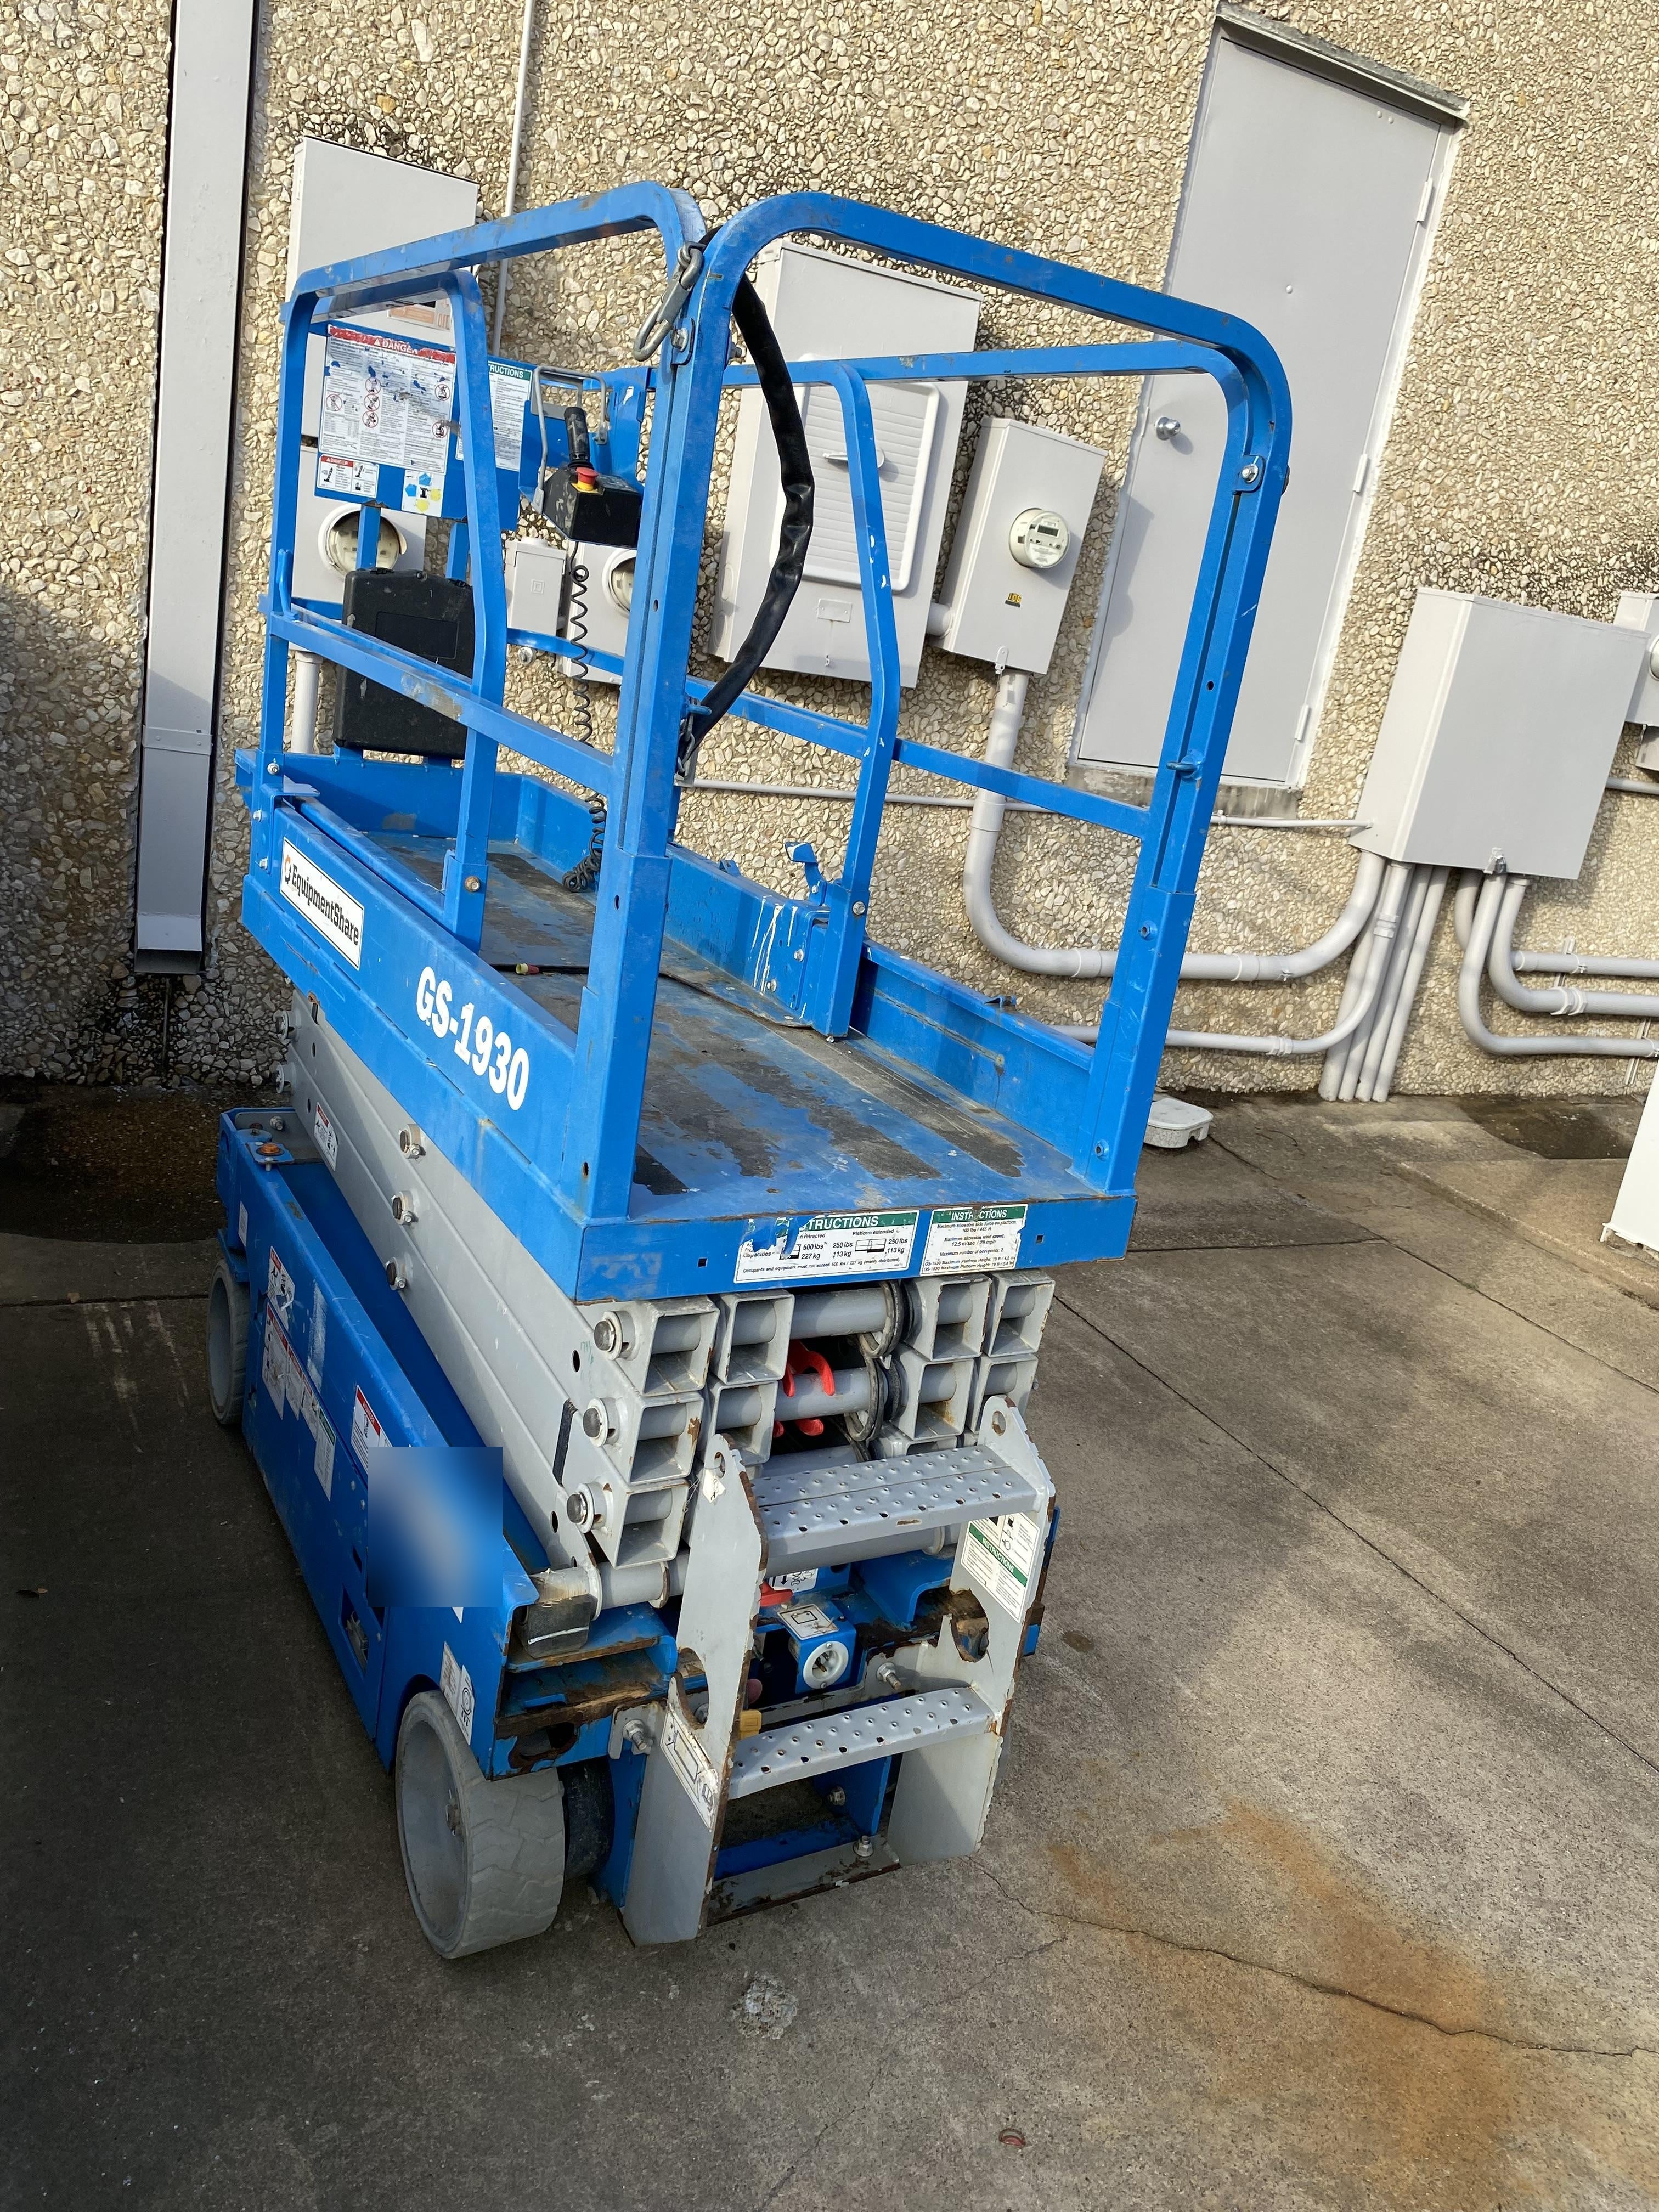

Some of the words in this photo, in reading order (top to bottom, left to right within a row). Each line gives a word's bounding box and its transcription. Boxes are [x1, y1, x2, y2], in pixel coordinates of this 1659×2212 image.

[488, 364, 523, 379] RUCTIONS
[291, 863, 359, 946] EquipmentShare
[416, 966, 529, 1111] GS-1930
[951, 1209, 1007, 1221] INSTRCTIONS
[982, 1537, 1014, 1573] INSTRUCTIONS
